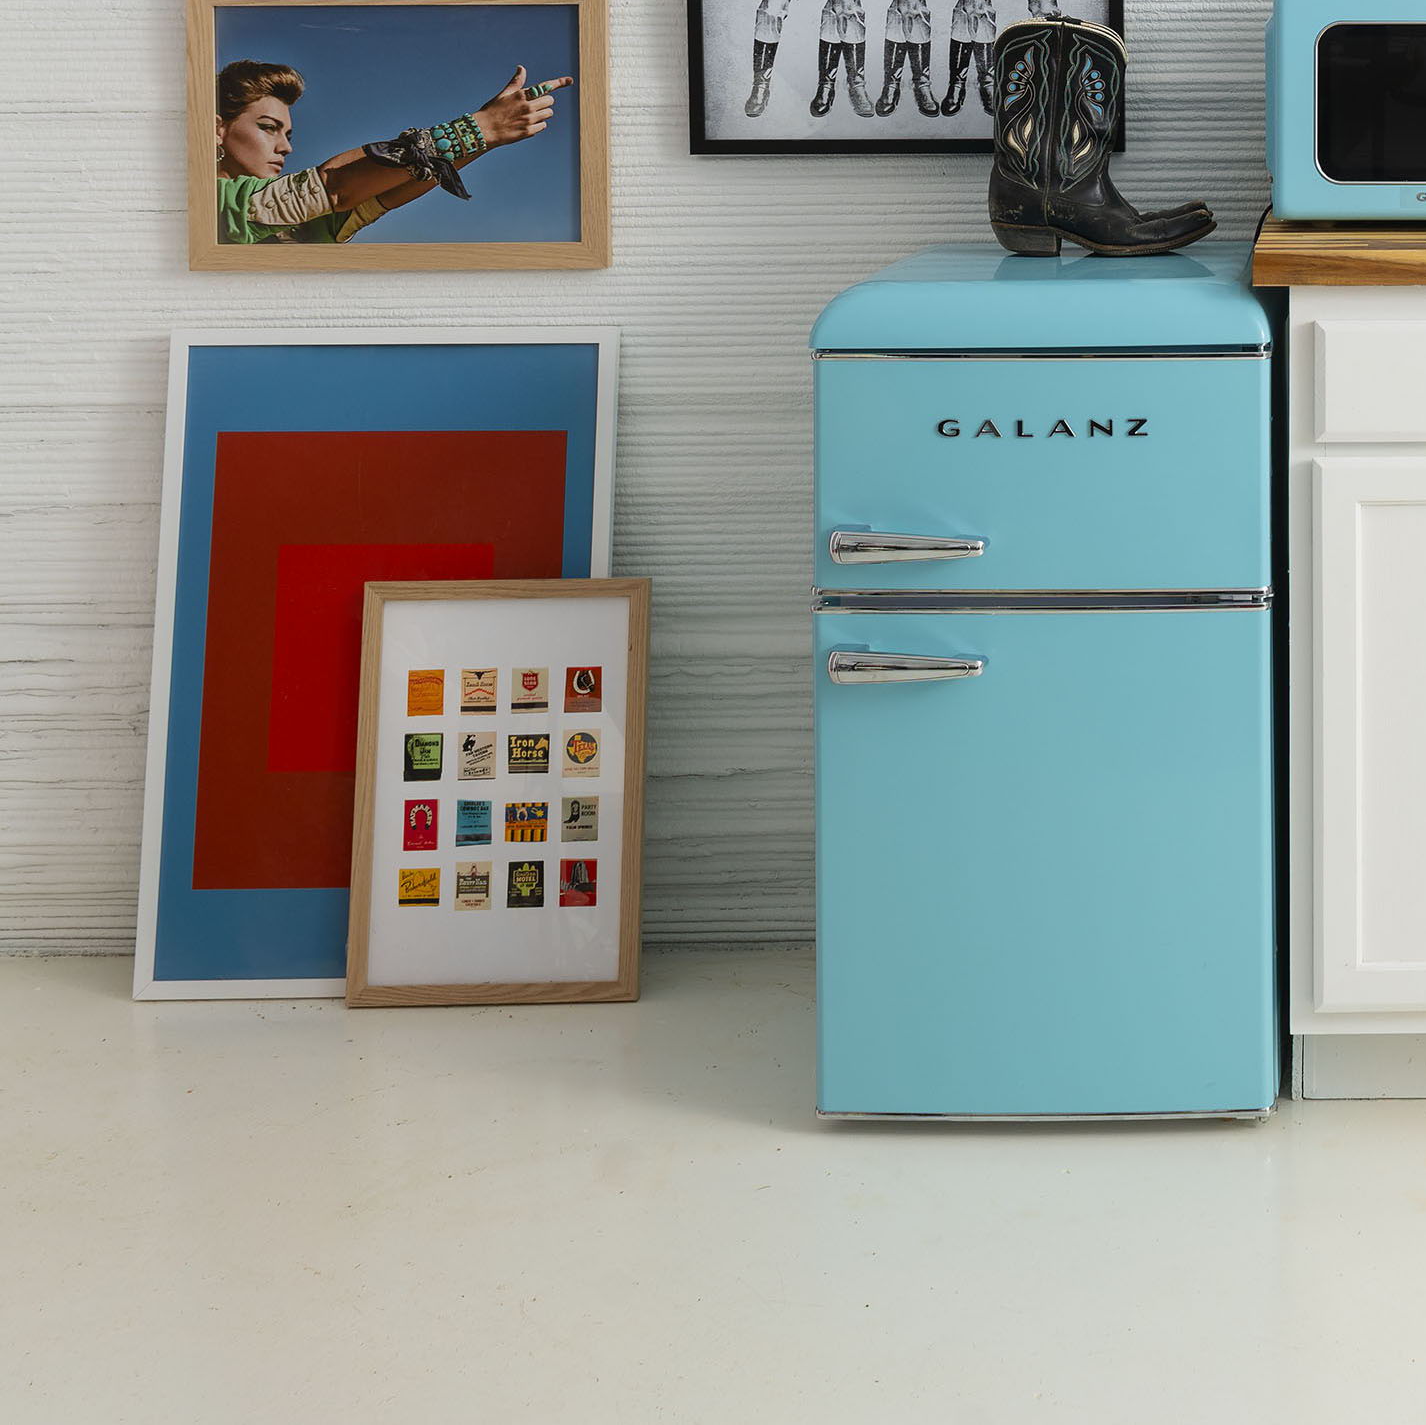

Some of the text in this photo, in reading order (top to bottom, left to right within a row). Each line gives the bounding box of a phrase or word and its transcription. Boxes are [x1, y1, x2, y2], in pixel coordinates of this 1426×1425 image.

[937, 418, 1148, 437] GALANZ
[510, 736, 534, 747] Iron
[511, 748, 544, 758] Horse
